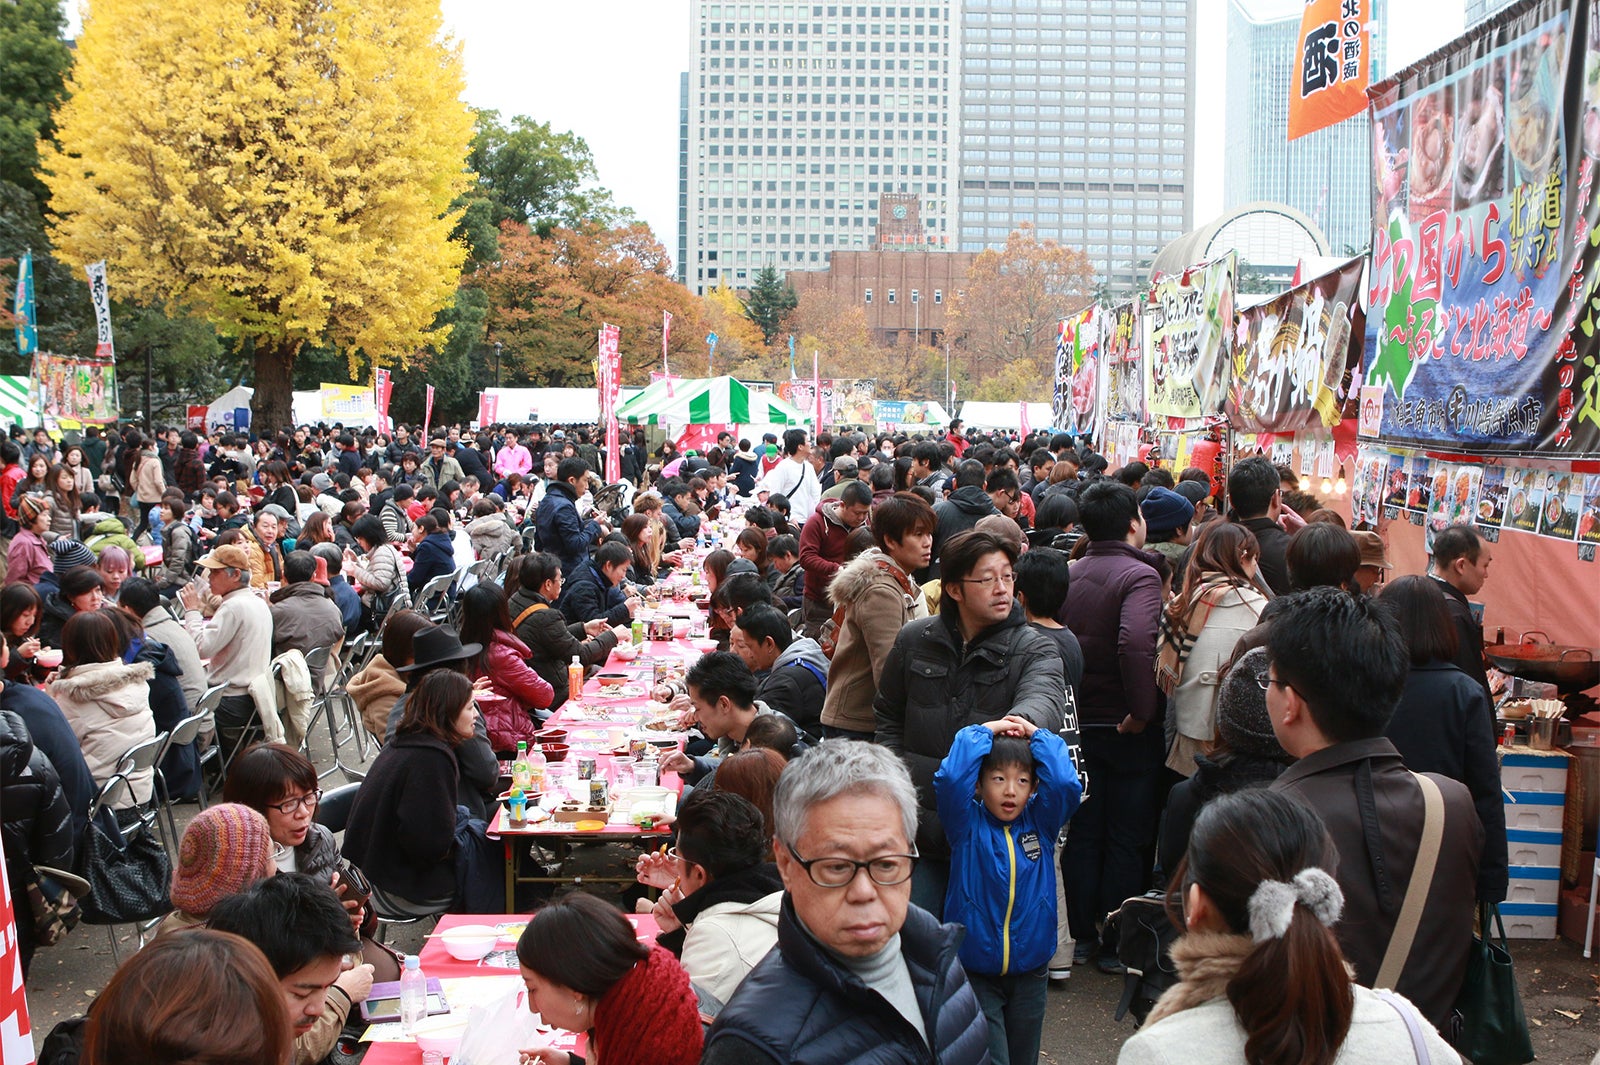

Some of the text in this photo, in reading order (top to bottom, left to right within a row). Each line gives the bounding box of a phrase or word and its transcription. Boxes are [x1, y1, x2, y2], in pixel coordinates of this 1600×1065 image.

[1508, 173, 1562, 239] 北海道
[1369, 201, 1506, 306] 北の国から
